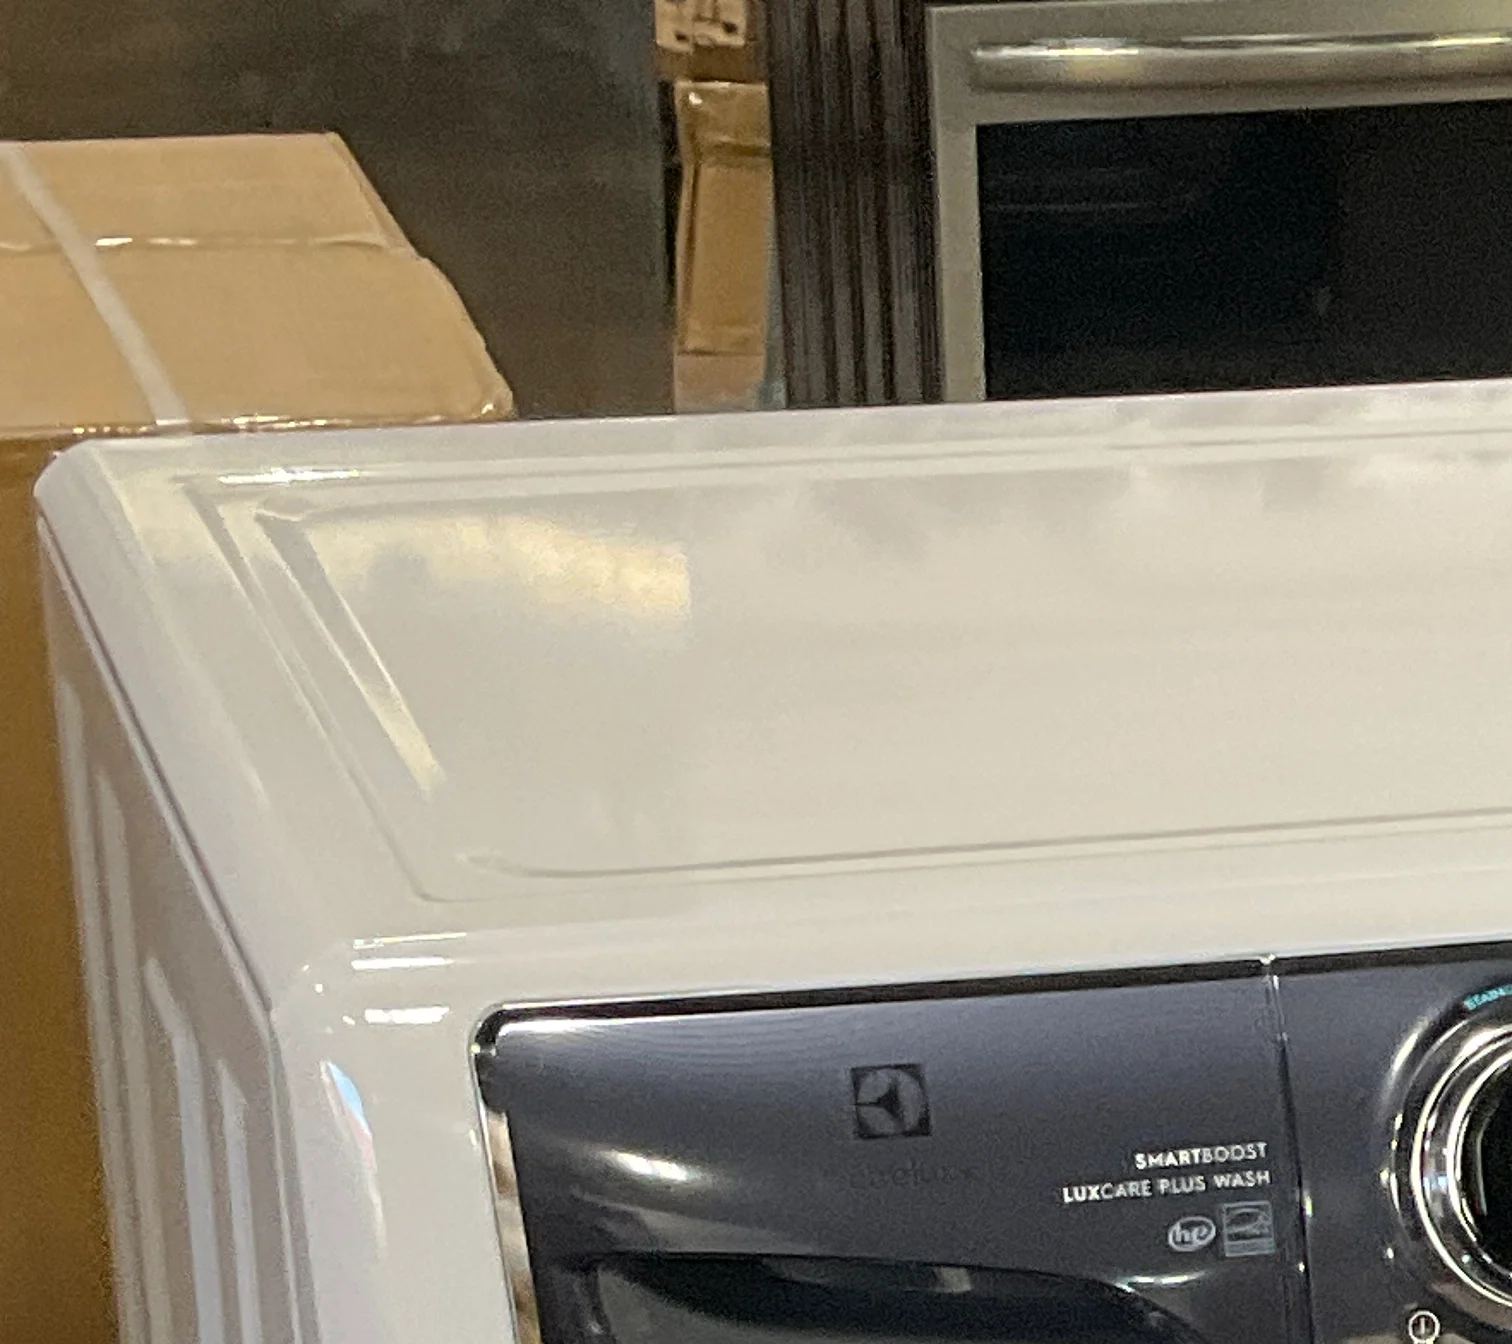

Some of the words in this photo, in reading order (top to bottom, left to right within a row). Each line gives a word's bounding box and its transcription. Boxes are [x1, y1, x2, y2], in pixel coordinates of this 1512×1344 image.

[1134, 1142, 1267, 1170] SMARTBOOST
[1062, 1179, 1152, 1204] LUXCARE
[1158, 1175, 1206, 1196] PLUS
[1213, 1170, 1271, 1191] WASH
